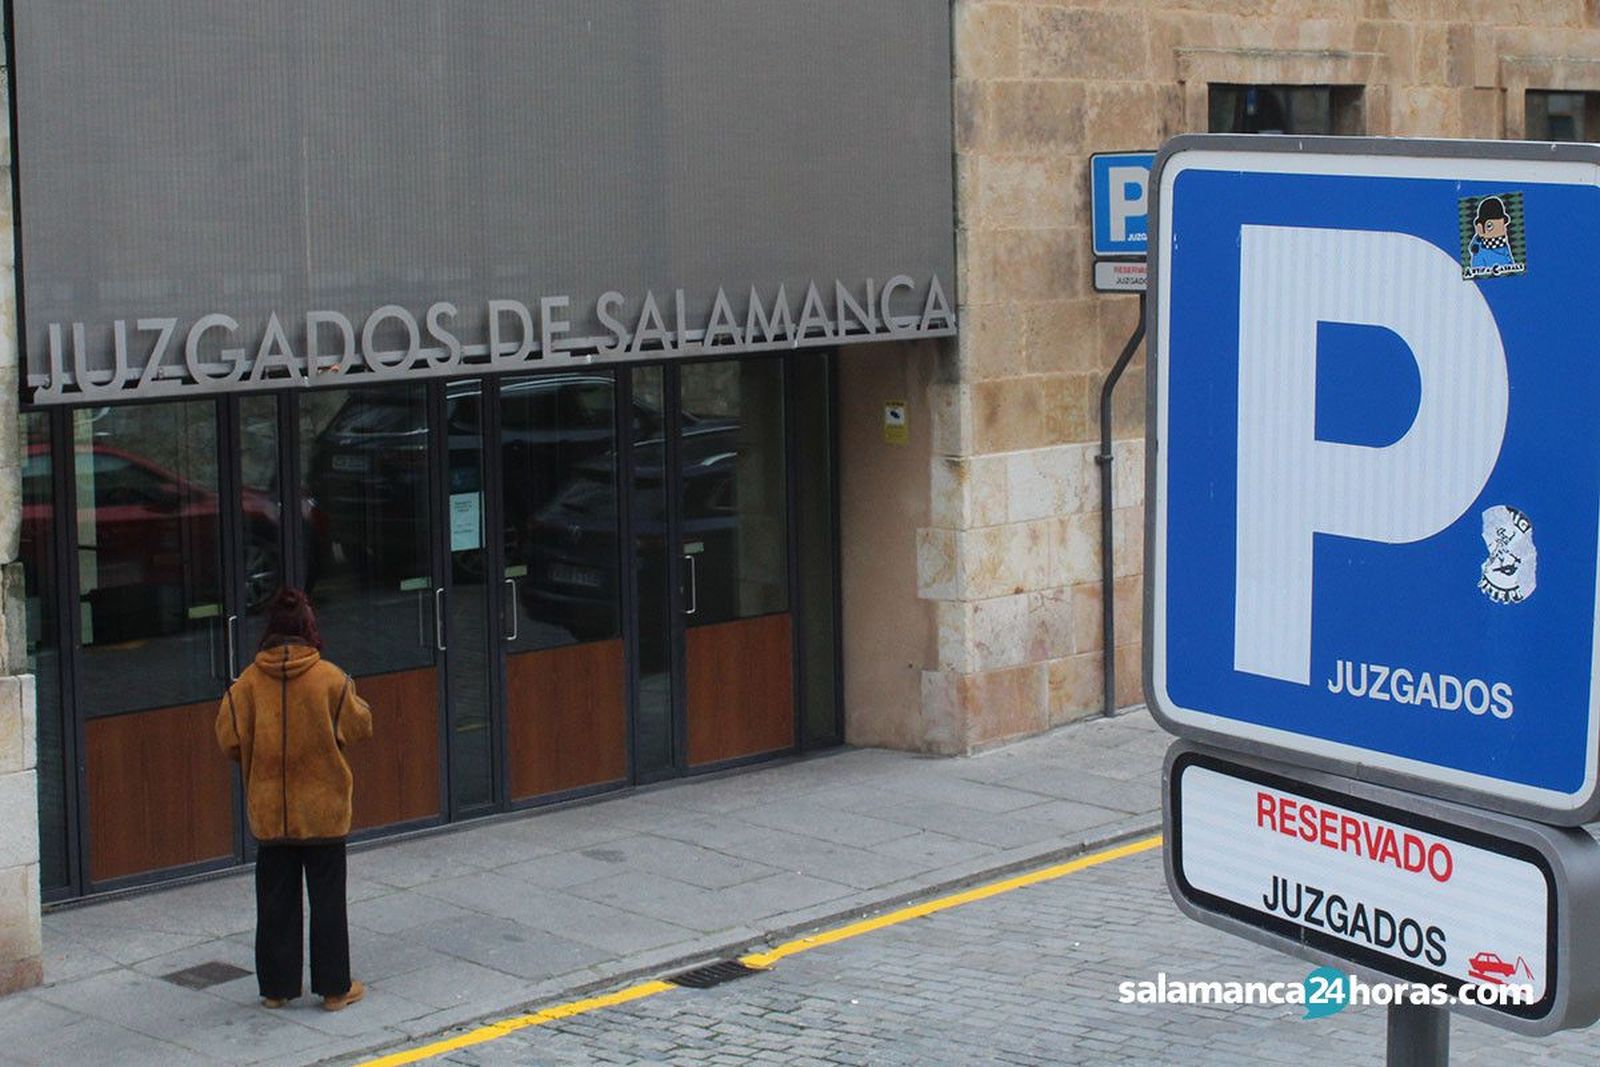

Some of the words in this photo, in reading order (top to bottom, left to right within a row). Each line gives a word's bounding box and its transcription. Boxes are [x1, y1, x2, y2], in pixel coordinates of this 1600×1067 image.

[1109, 166, 1149, 241] P
[1128, 232, 1148, 242] JUZG
[1114, 266, 1147, 275] RESERVA
[40, 301, 463, 395] JUZGADOS
[488, 294, 571, 362] DE
[596, 274, 957, 355] SALAMANCA
[1235, 224, 1509, 685] P
[1328, 660, 1514, 720] JUZGADOS
[1256, 792, 1454, 882] RESERVADO
[1263, 876, 1448, 966] JUZGADOS
